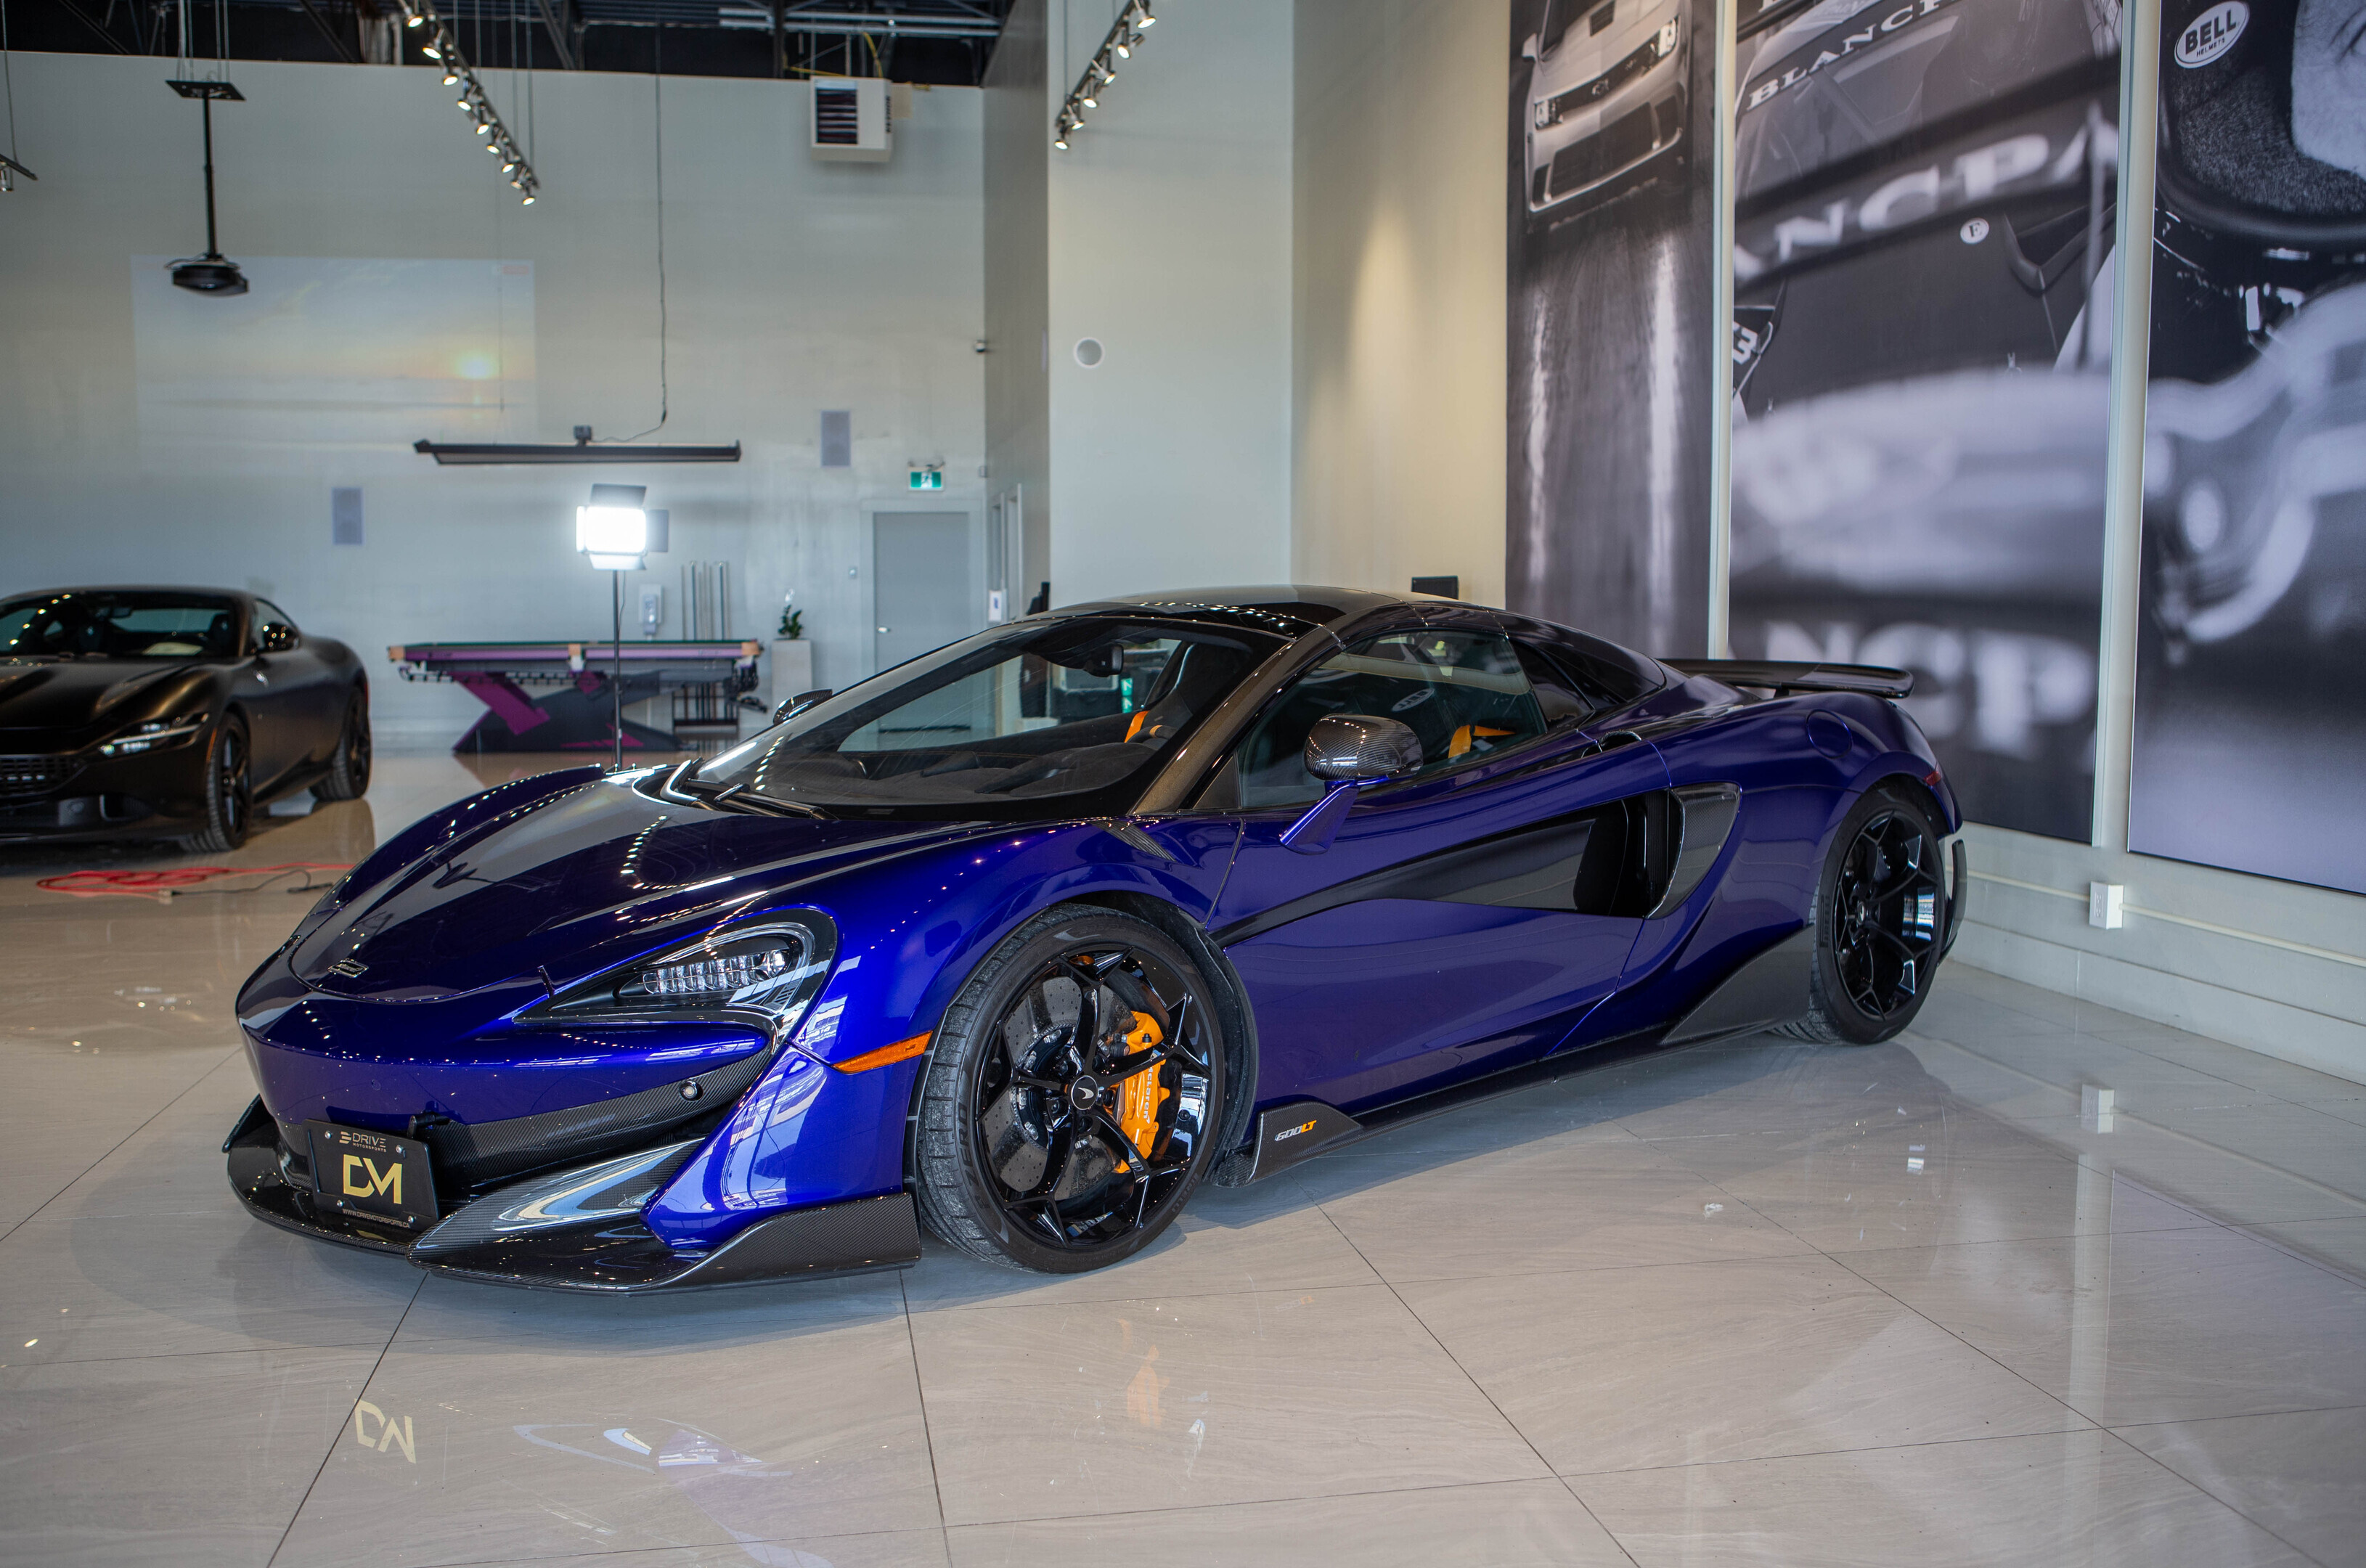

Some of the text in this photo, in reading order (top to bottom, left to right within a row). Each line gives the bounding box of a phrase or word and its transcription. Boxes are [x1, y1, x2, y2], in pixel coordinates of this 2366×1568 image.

[2185, 9, 2237, 55] BELL
[2196, 37, 2225, 57] HELMETS
[1968, 221, 1983, 238] E
[352, 1132, 386, 1148] DRIVE
[1274, 1119, 1317, 1142] 600LT
[352, 1143, 387, 1152] MOTORSPORTS
[958, 1101, 980, 1187] ZERO
[343, 1153, 403, 1205] DM
